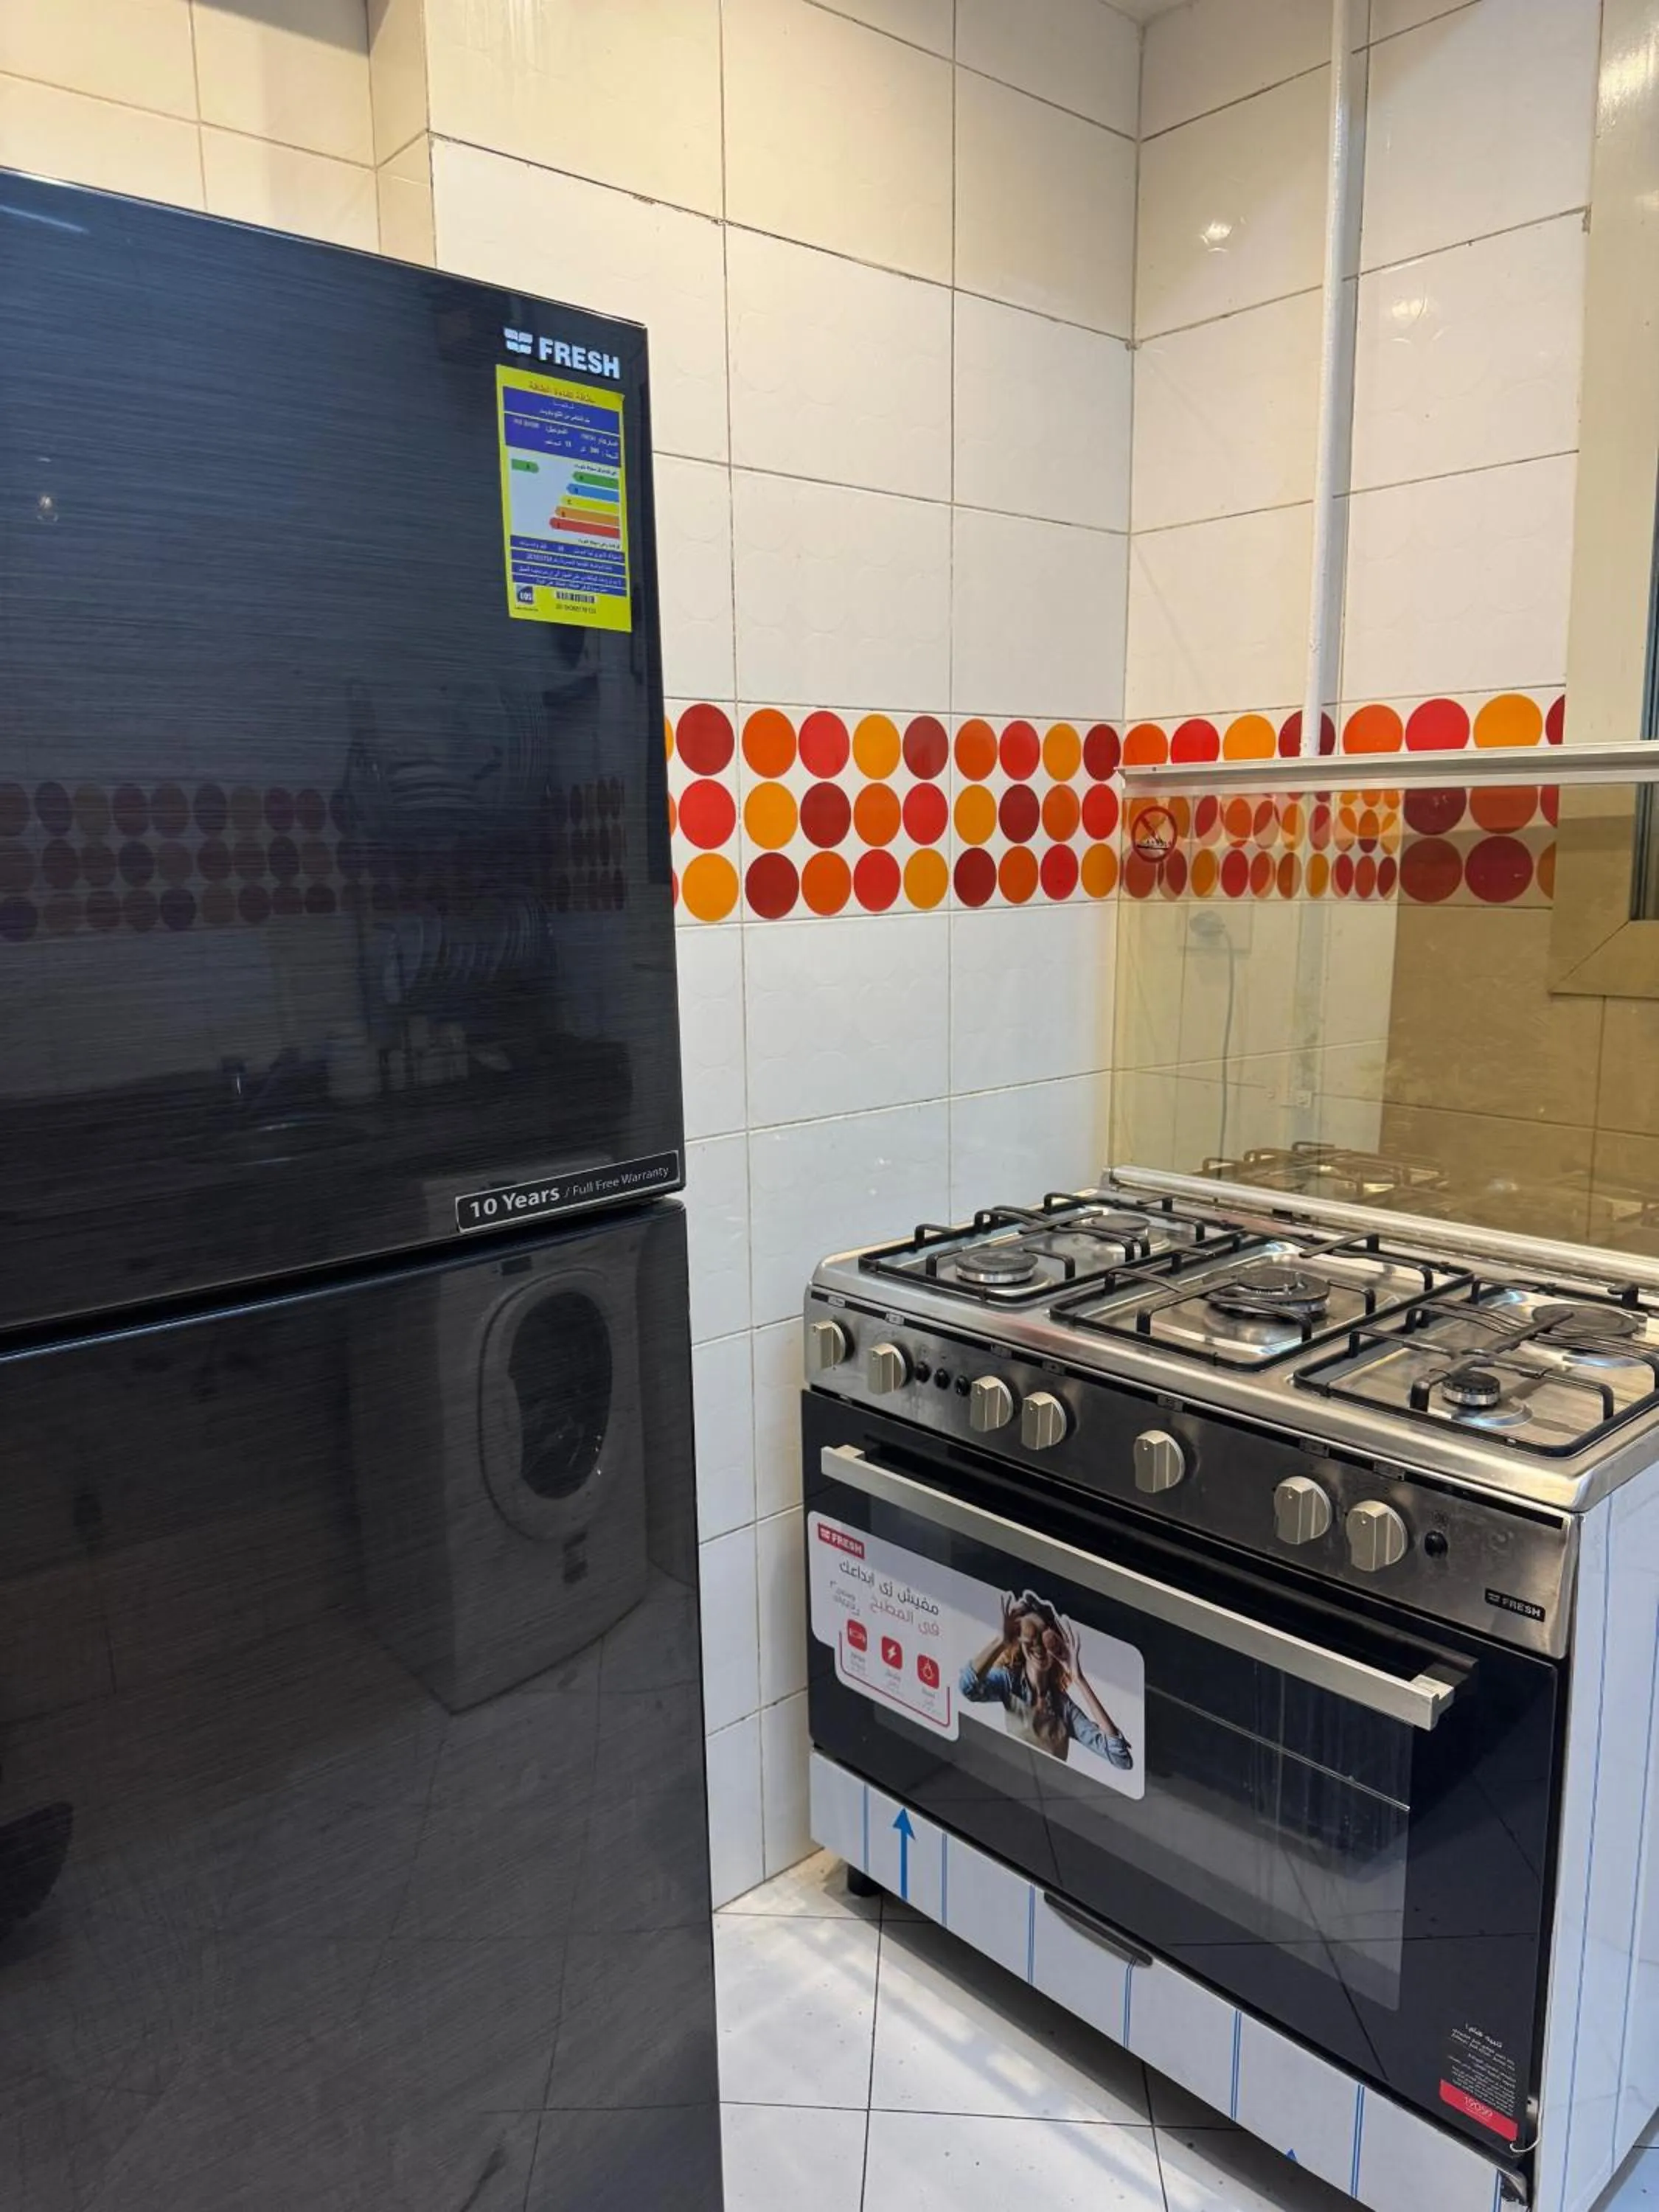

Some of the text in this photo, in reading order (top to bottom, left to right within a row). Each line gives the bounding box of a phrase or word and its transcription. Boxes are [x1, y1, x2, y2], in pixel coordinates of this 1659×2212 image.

[539, 336, 620, 379] FRESH
[470, 1198, 498, 1218] 10
[501, 1186, 560, 1211] Years
[572, 1182, 594, 1196] Full
[595, 1178, 619, 1192] Free
[621, 1166, 669, 1185] Warranty
[831, 1532, 863, 1555] FRESH
[870, 1595, 914, 1625] المطبخ
[1502, 1598, 1541, 1618] FRESH
